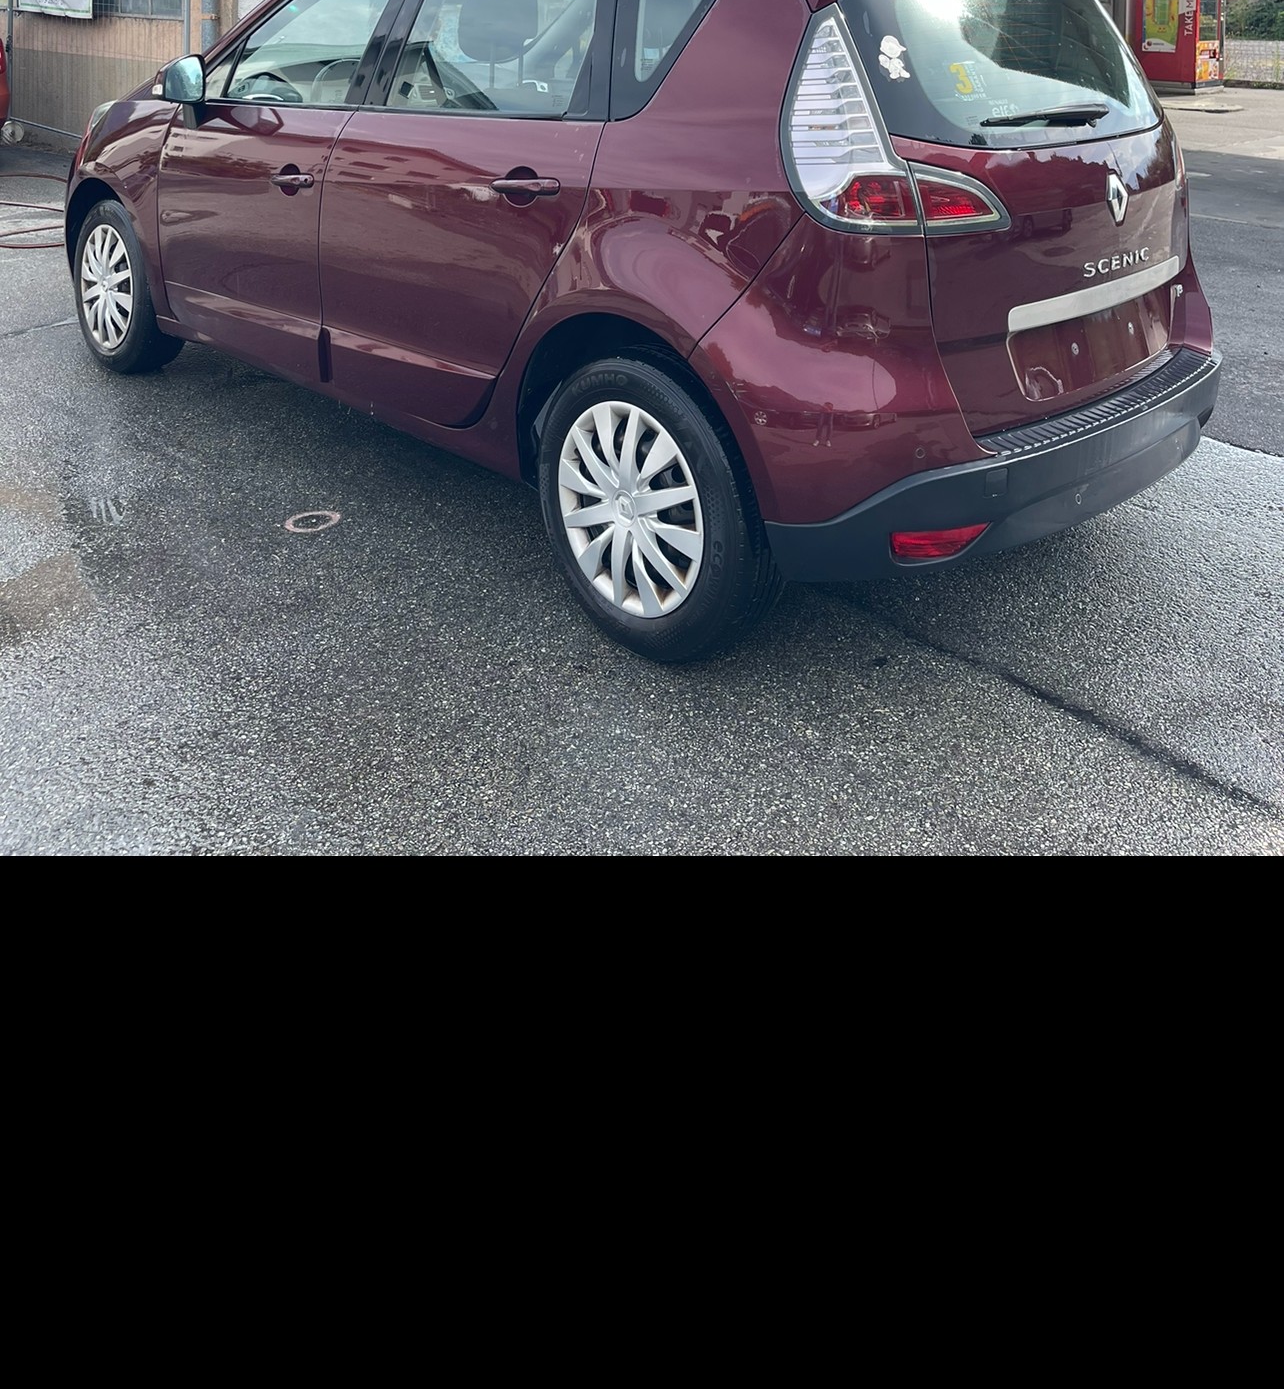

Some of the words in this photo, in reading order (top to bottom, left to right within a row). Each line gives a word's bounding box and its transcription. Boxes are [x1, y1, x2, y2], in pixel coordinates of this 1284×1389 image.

[1184, 11, 1194, 36] TAKE
[949, 63, 974, 95] 3
[1083, 246, 1150, 278] SCENIC
[571, 373, 628, 395] KUMHO
